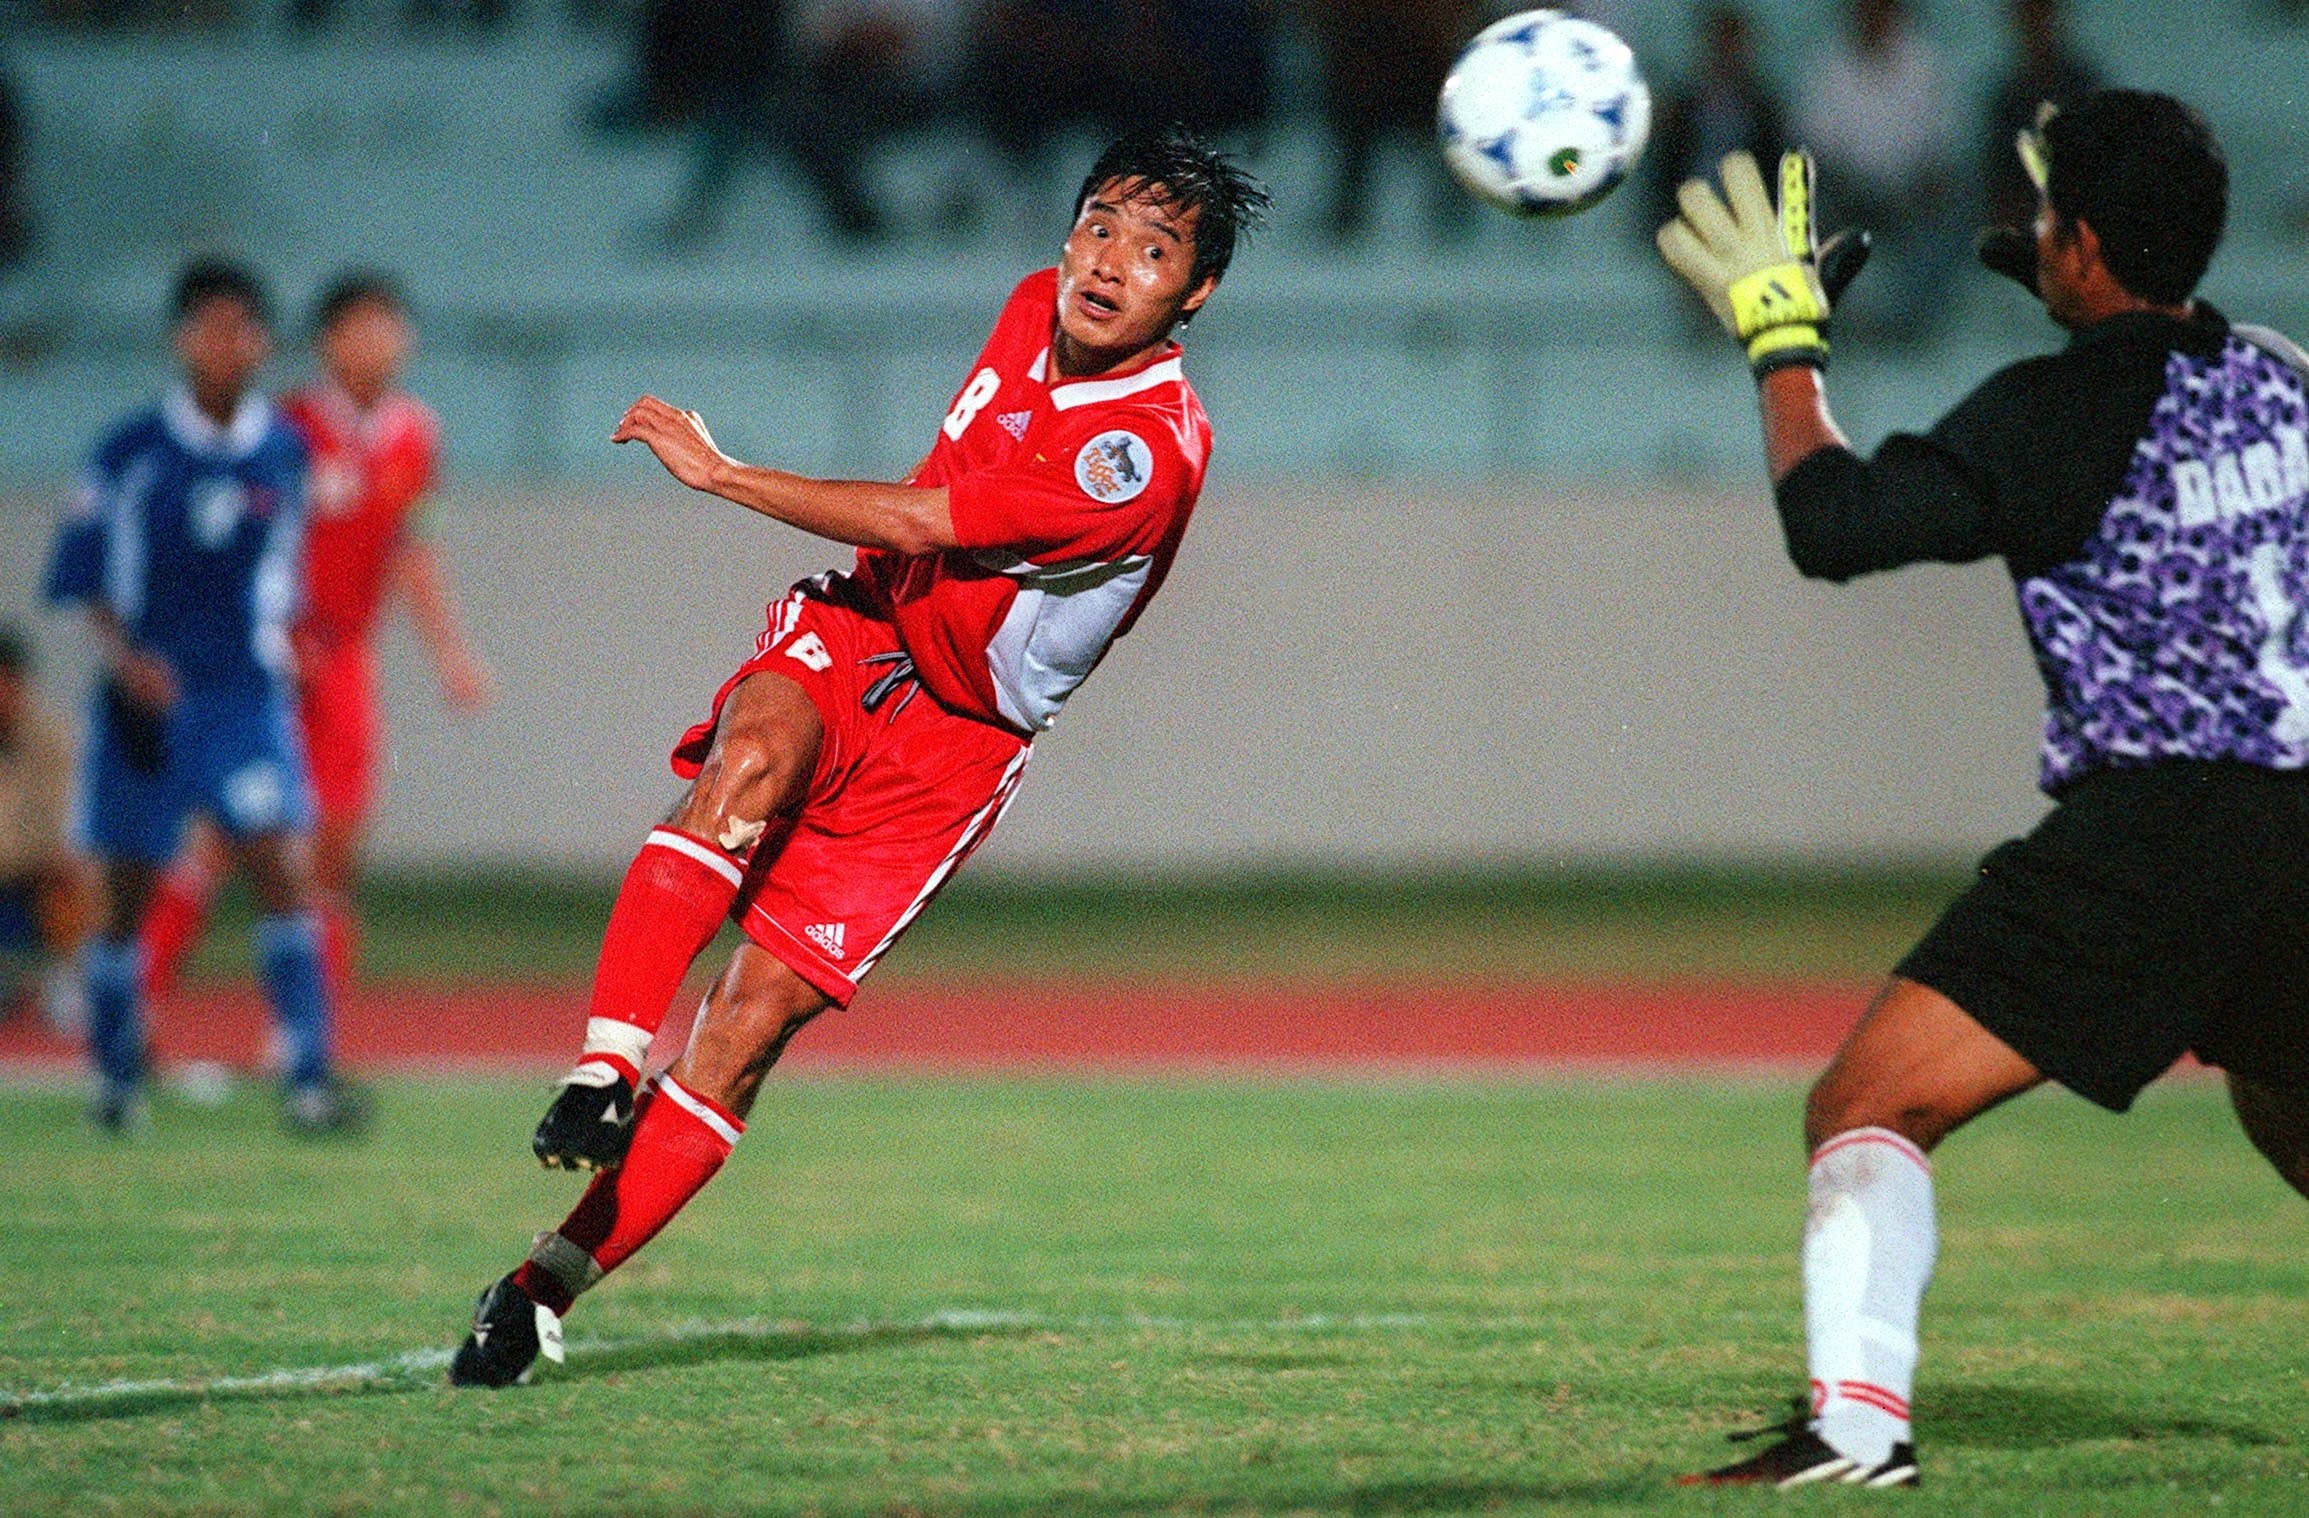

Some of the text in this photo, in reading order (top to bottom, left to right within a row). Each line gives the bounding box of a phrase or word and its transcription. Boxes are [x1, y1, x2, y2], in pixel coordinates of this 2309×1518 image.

[943, 367, 1001, 441] 8
[784, 630, 833, 672] 8
[804, 924, 846, 960] adidas
